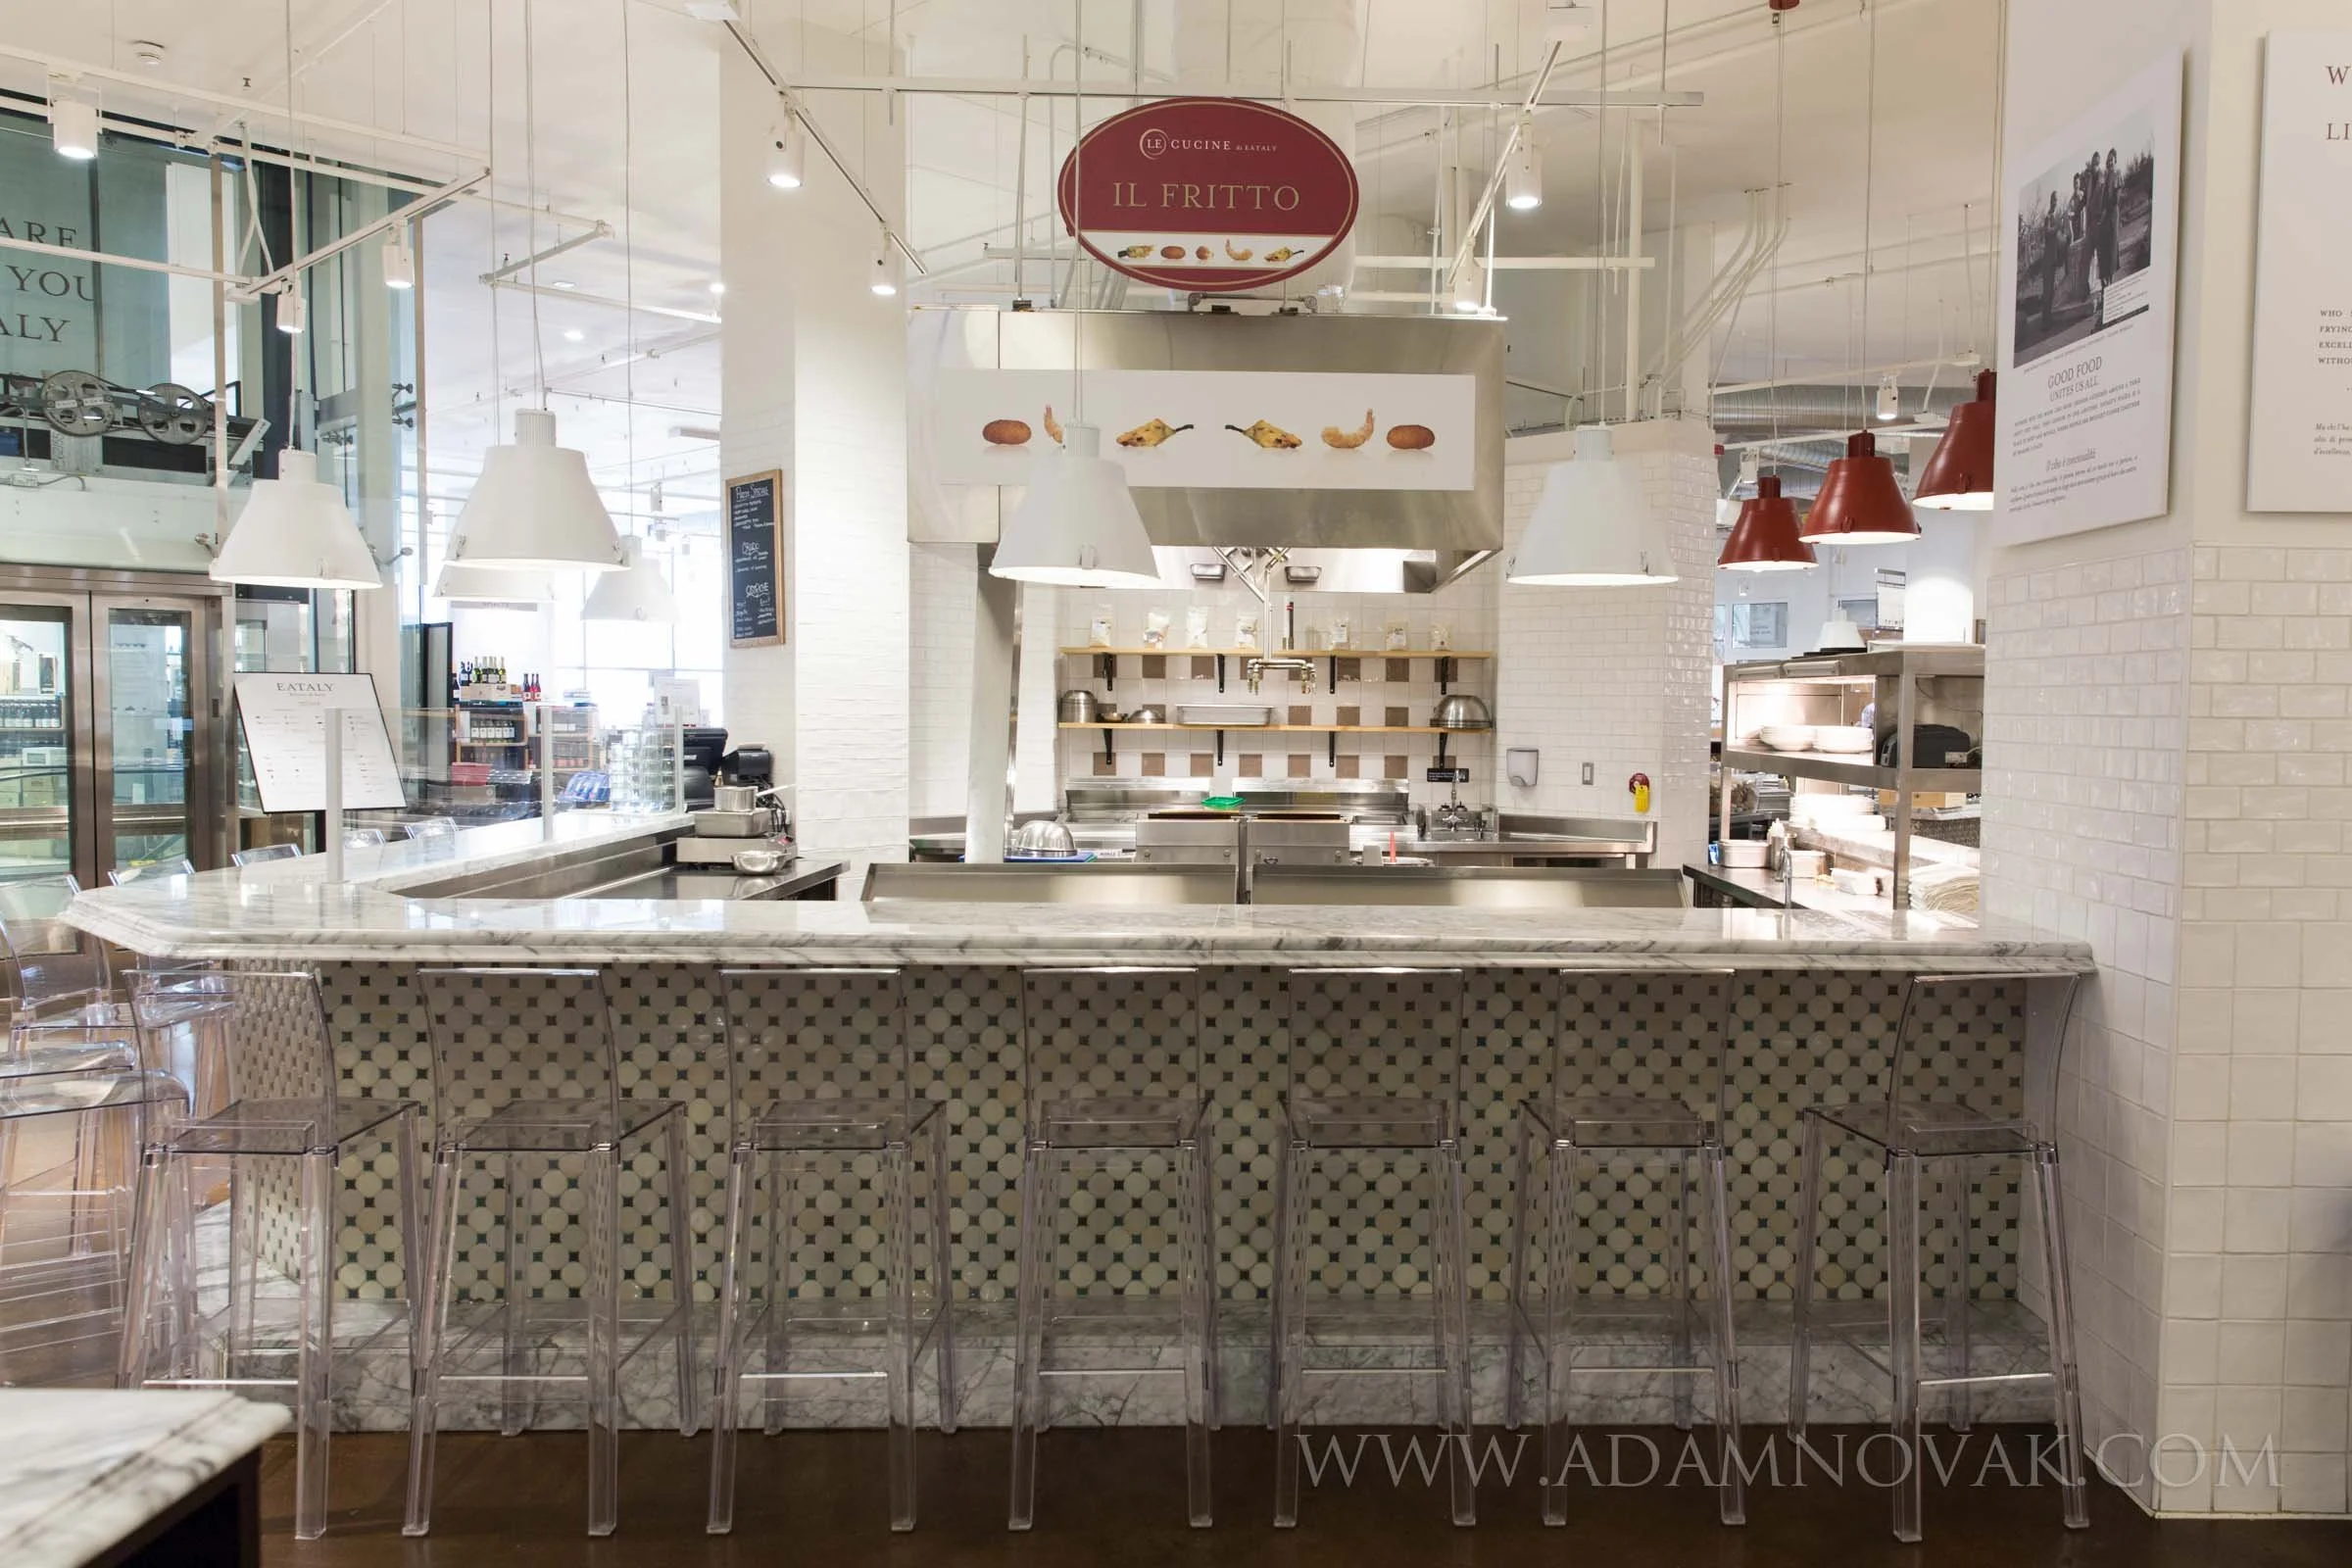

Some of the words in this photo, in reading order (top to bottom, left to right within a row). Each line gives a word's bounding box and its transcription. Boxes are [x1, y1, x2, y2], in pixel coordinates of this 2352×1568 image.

[1147, 138, 1162, 149] LE
[1170, 139, 1231, 150] CUCINE
[1113, 182, 1148, 208] IL
[1160, 183, 1300, 211] FRITTO
[5, 265, 95, 302] YOU
[2047, 368, 2075, 390] GOOD
[2077, 356, 2102, 378] FOOD
[2049, 384, 2075, 402] UNITES
[276, 682, 335, 692] EATALY
